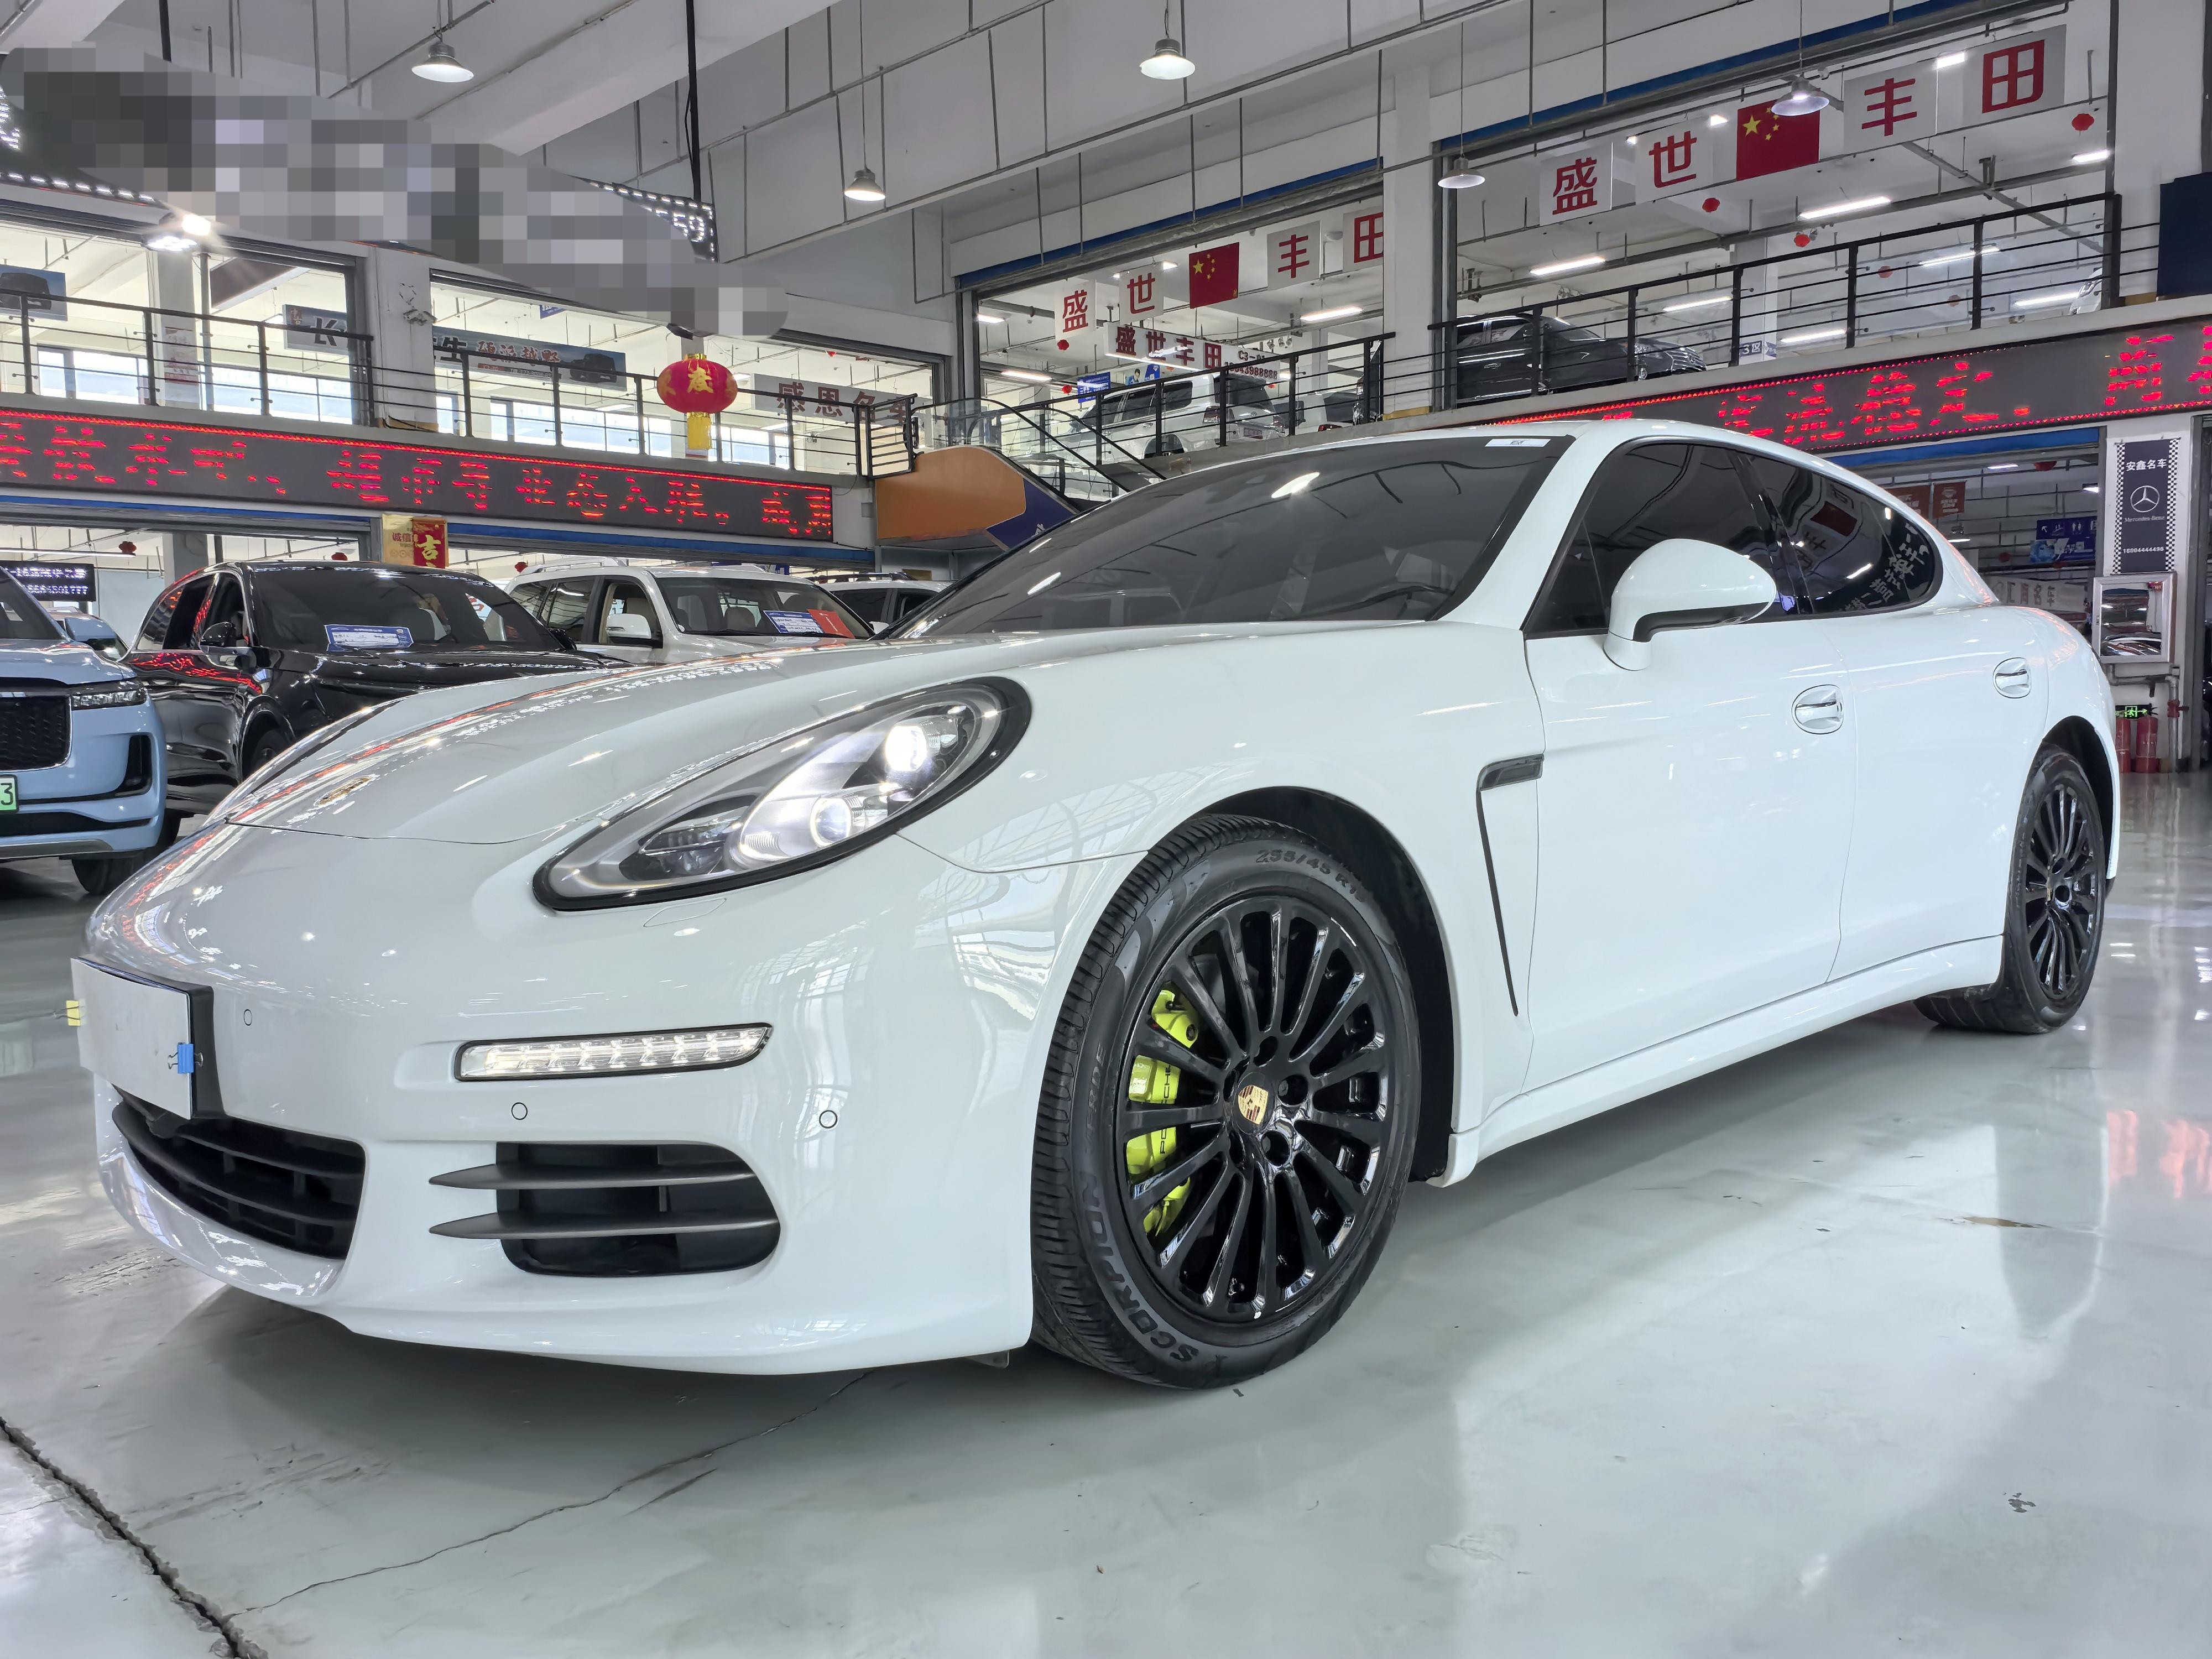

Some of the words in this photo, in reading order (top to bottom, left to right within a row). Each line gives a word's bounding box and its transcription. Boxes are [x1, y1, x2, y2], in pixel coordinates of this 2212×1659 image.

[1115, 325, 1222, 369] 盛世丰田
[2126, 458, 2167, 471] 安鑫名车
[1079, 1170, 1200, 1364] SCORPION
